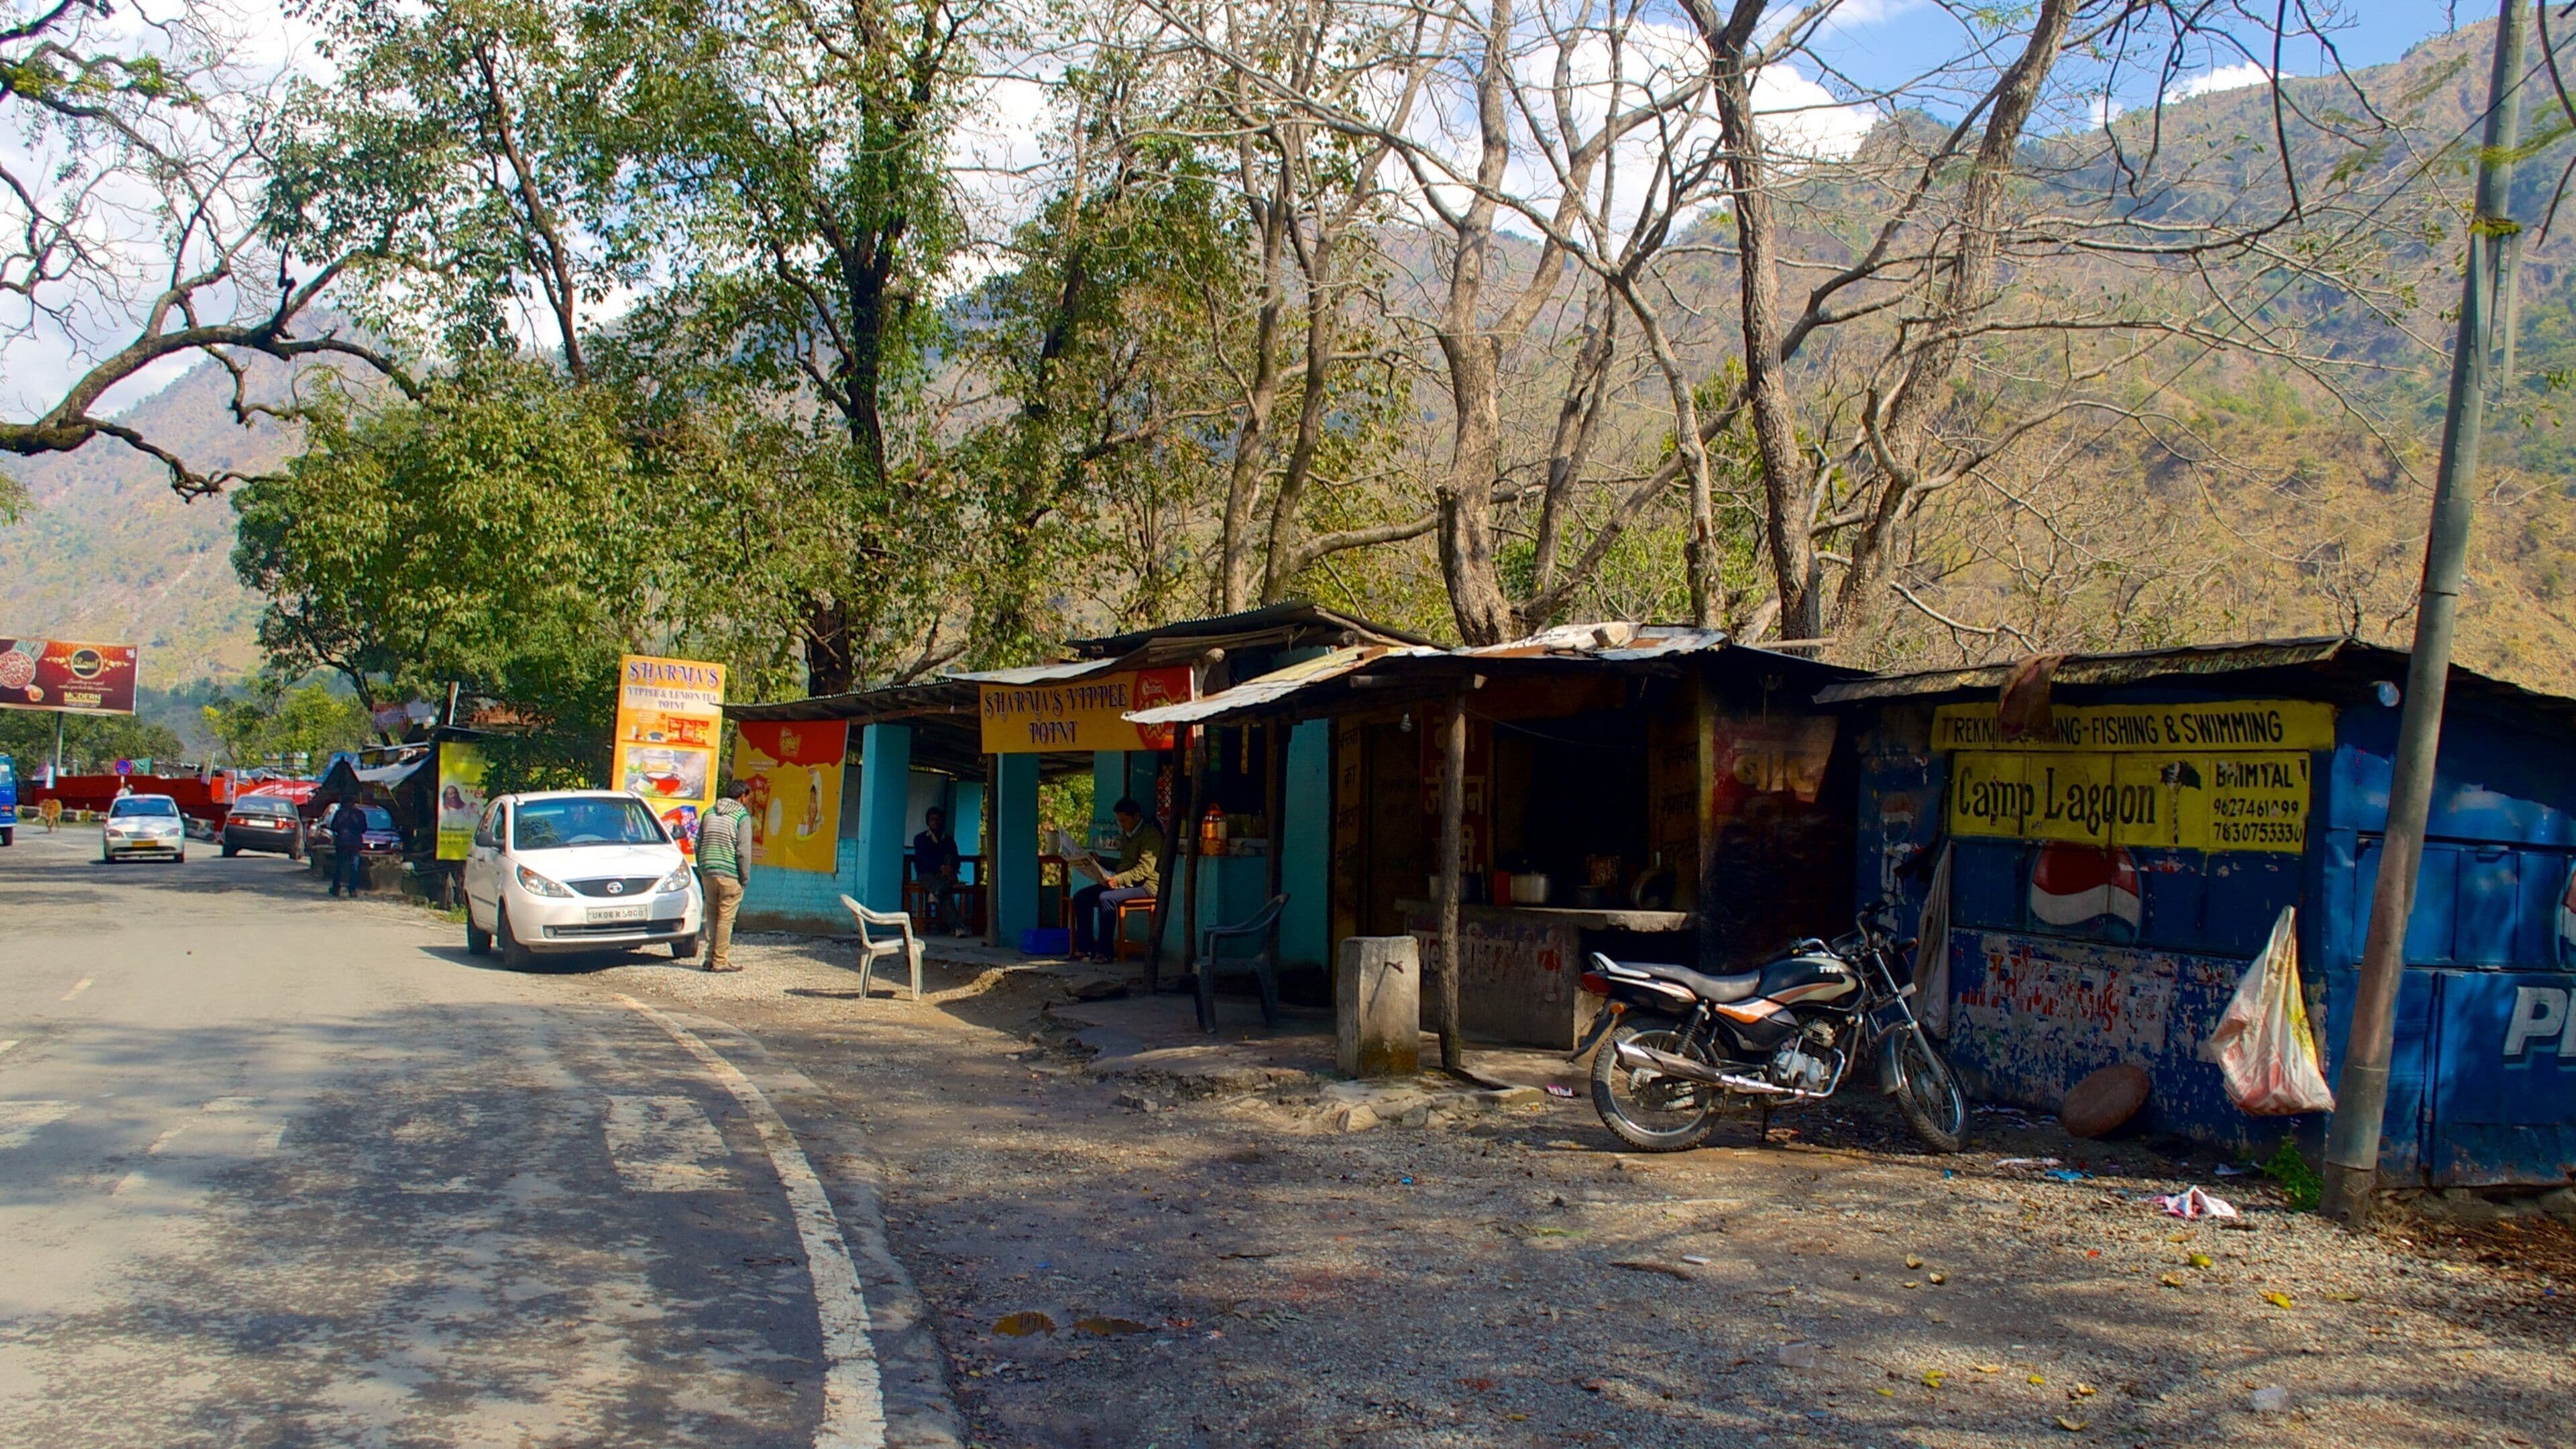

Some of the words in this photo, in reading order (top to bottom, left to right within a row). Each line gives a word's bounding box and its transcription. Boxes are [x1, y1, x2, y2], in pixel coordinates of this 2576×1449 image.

[628, 661, 719, 689] SHARMA'S
[657, 700, 686, 710] POINT
[669, 690, 700, 701] LEMON
[702, 693, 716, 702] TEA
[985, 690, 1063, 722] SHARMA'S
[1067, 684, 1128, 711] YIPPEE
[1028, 720, 1079, 745] POINT
[2163, 714, 2180, 743] &
[2180, 710, 2283, 743] SWIMMING
[1959, 766, 2035, 835] Camp
[2044, 767, 2155, 836] Lagoon
[1819, 965, 1840, 974] TVS
